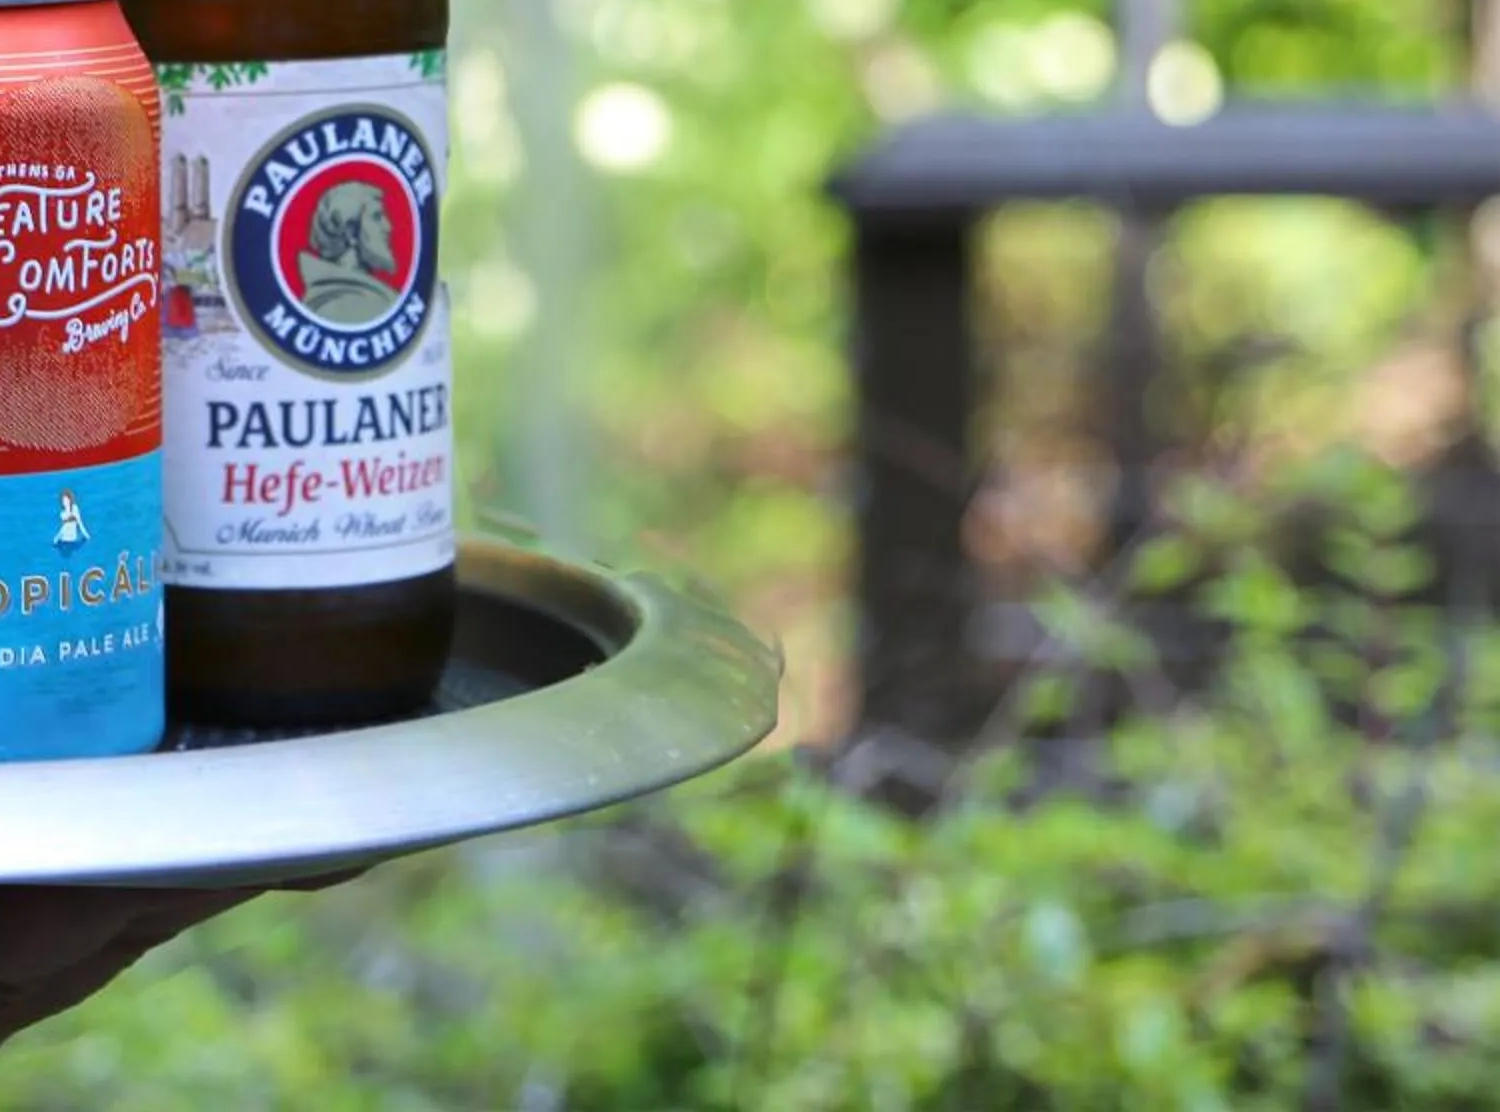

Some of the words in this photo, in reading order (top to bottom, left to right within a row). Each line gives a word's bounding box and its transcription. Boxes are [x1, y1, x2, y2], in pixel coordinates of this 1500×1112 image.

[55, 164, 76, 181] GA
[244, 118, 434, 219] PAULANER
[62, 309, 129, 353] Brewing
[263, 291, 425, 365] MÜNCHEN
[215, 516, 322, 545] Munich
[59, 632, 114, 662] PALE
[121, 622, 149, 649] ALE
